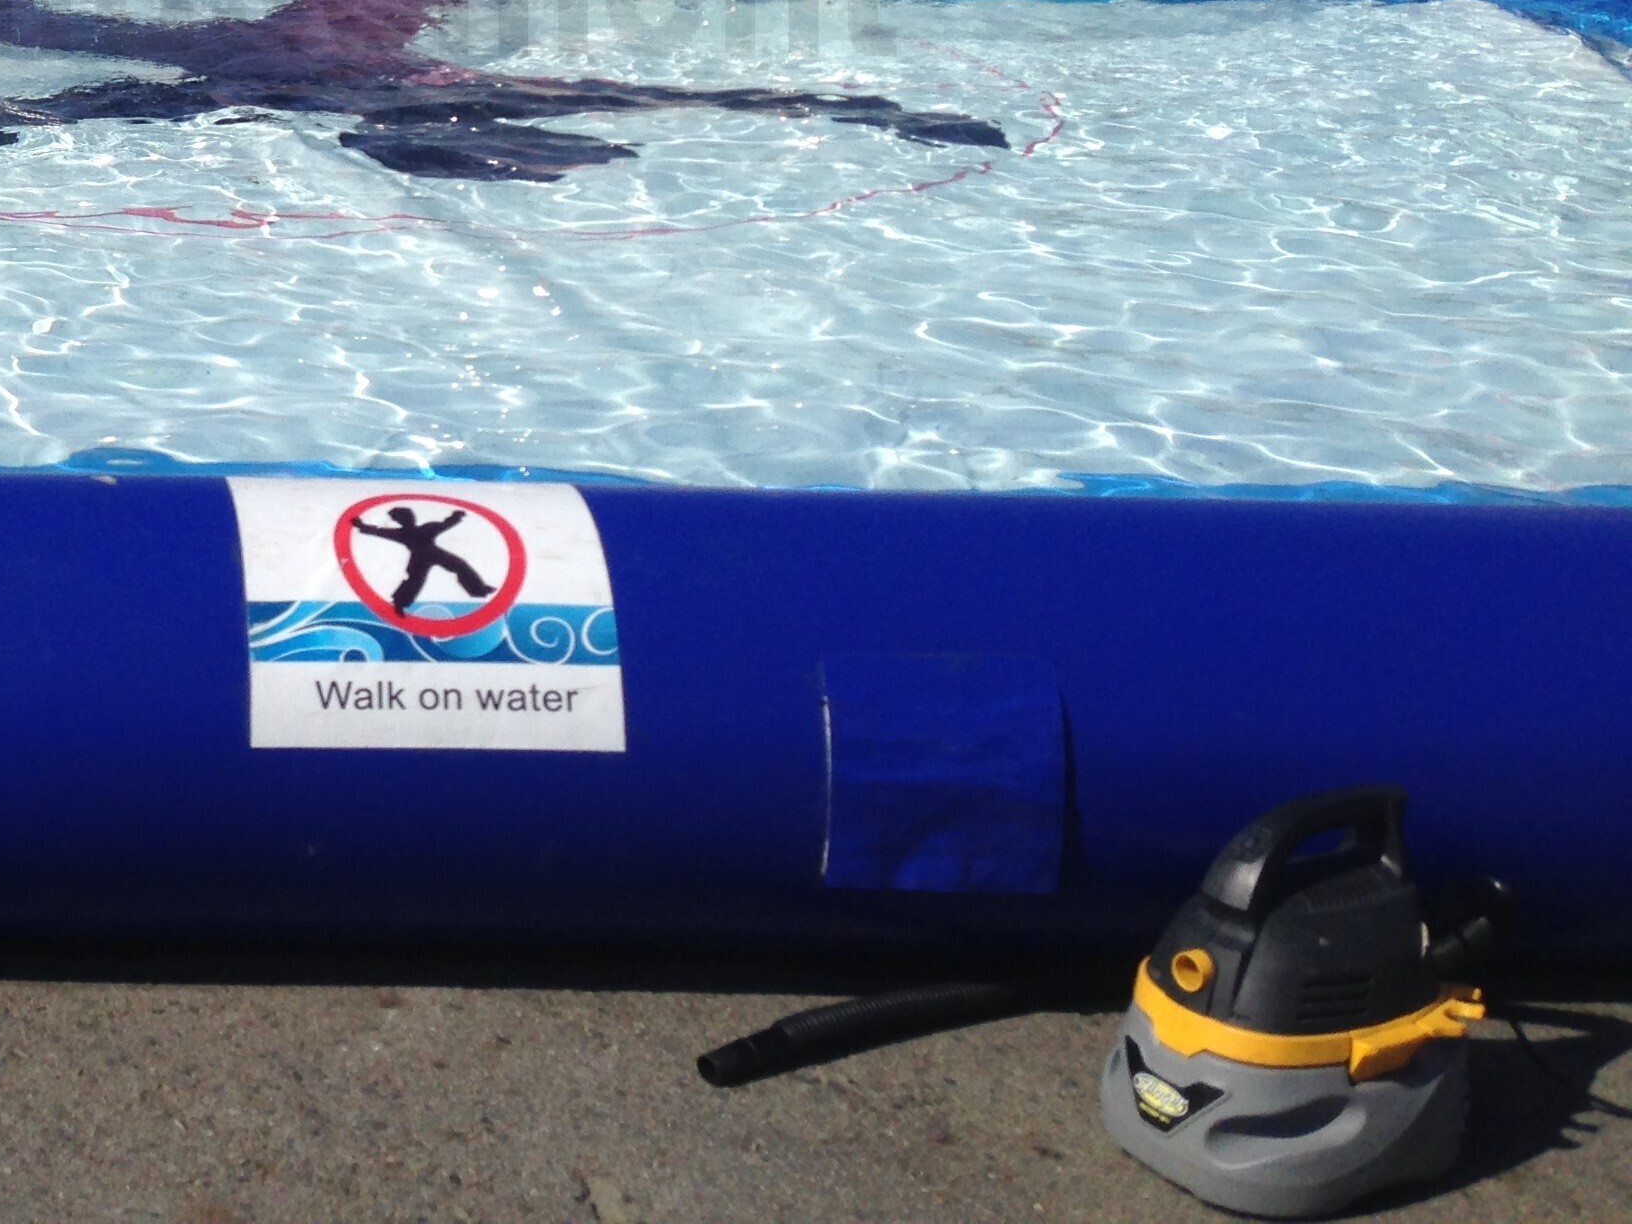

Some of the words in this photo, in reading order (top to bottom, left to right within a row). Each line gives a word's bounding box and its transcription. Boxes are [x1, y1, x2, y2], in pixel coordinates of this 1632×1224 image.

[315, 680, 406, 710] Walk
[418, 687, 462, 711] on
[475, 683, 579, 712] water
